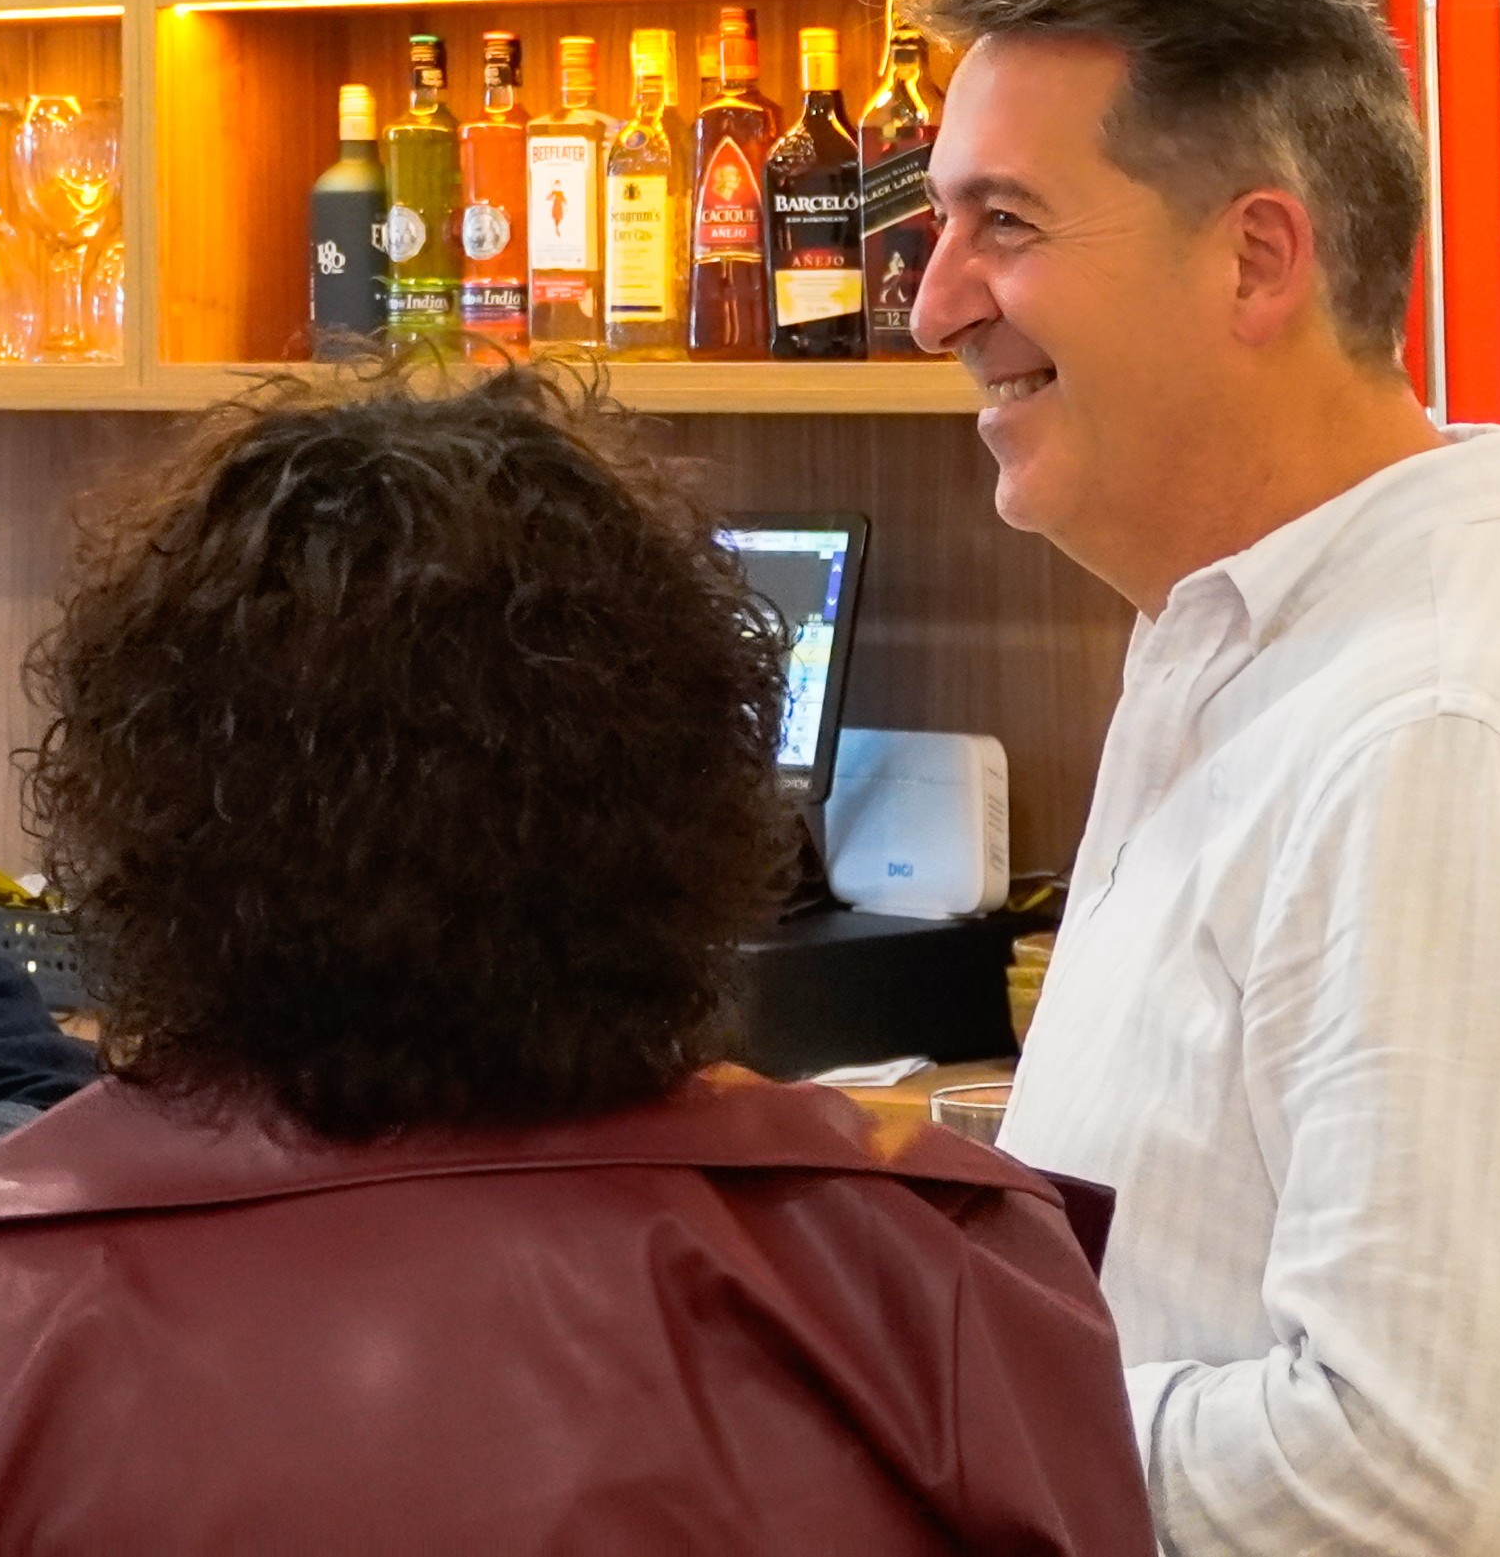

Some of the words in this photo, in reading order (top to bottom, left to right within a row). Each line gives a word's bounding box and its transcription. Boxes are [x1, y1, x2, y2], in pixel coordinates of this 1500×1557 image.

[533, 146, 585, 163] BEEFEATER
[774, 191, 860, 213] BARCELÓ
[701, 209, 757, 224] CACIQUE
[711, 226, 748, 239] AÑEJO
[792, 252, 846, 268] AÑEJO
[483, 289, 523, 306] India
[886, 311, 901, 326] 12
[888, 862, 914, 878] DIGI
